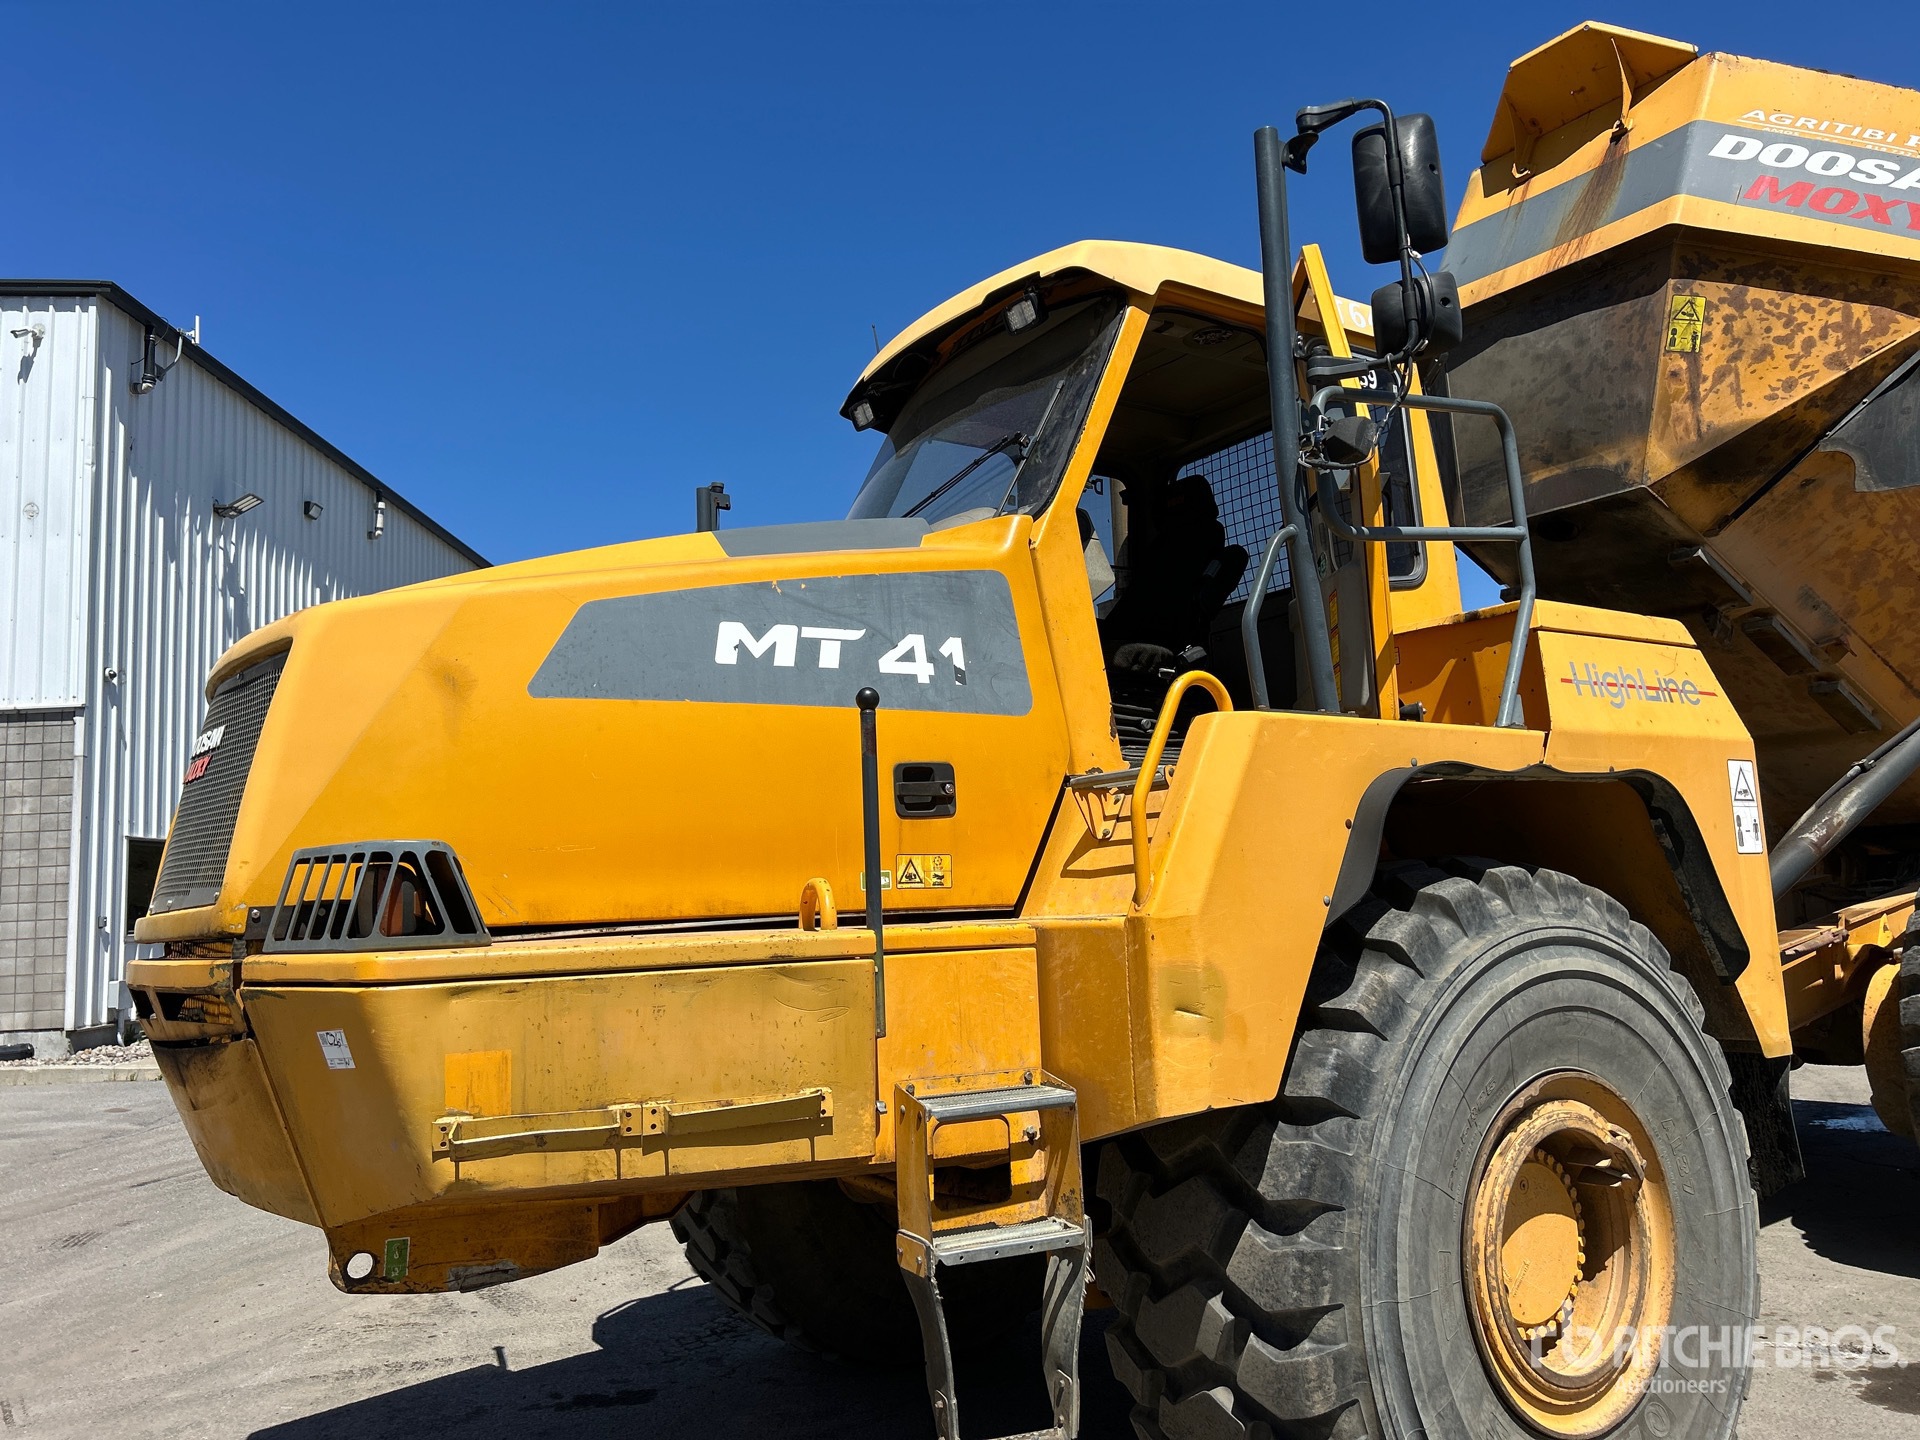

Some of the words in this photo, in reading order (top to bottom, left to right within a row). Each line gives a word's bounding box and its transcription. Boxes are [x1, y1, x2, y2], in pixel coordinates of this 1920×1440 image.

[1741, 109, 1897, 143] AGRITIBI
[1743, 174, 1920, 231] MOX
[714, 621, 867, 669] MT
[878, 633, 967, 685] 41
[1569, 661, 1701, 709] HighLine
